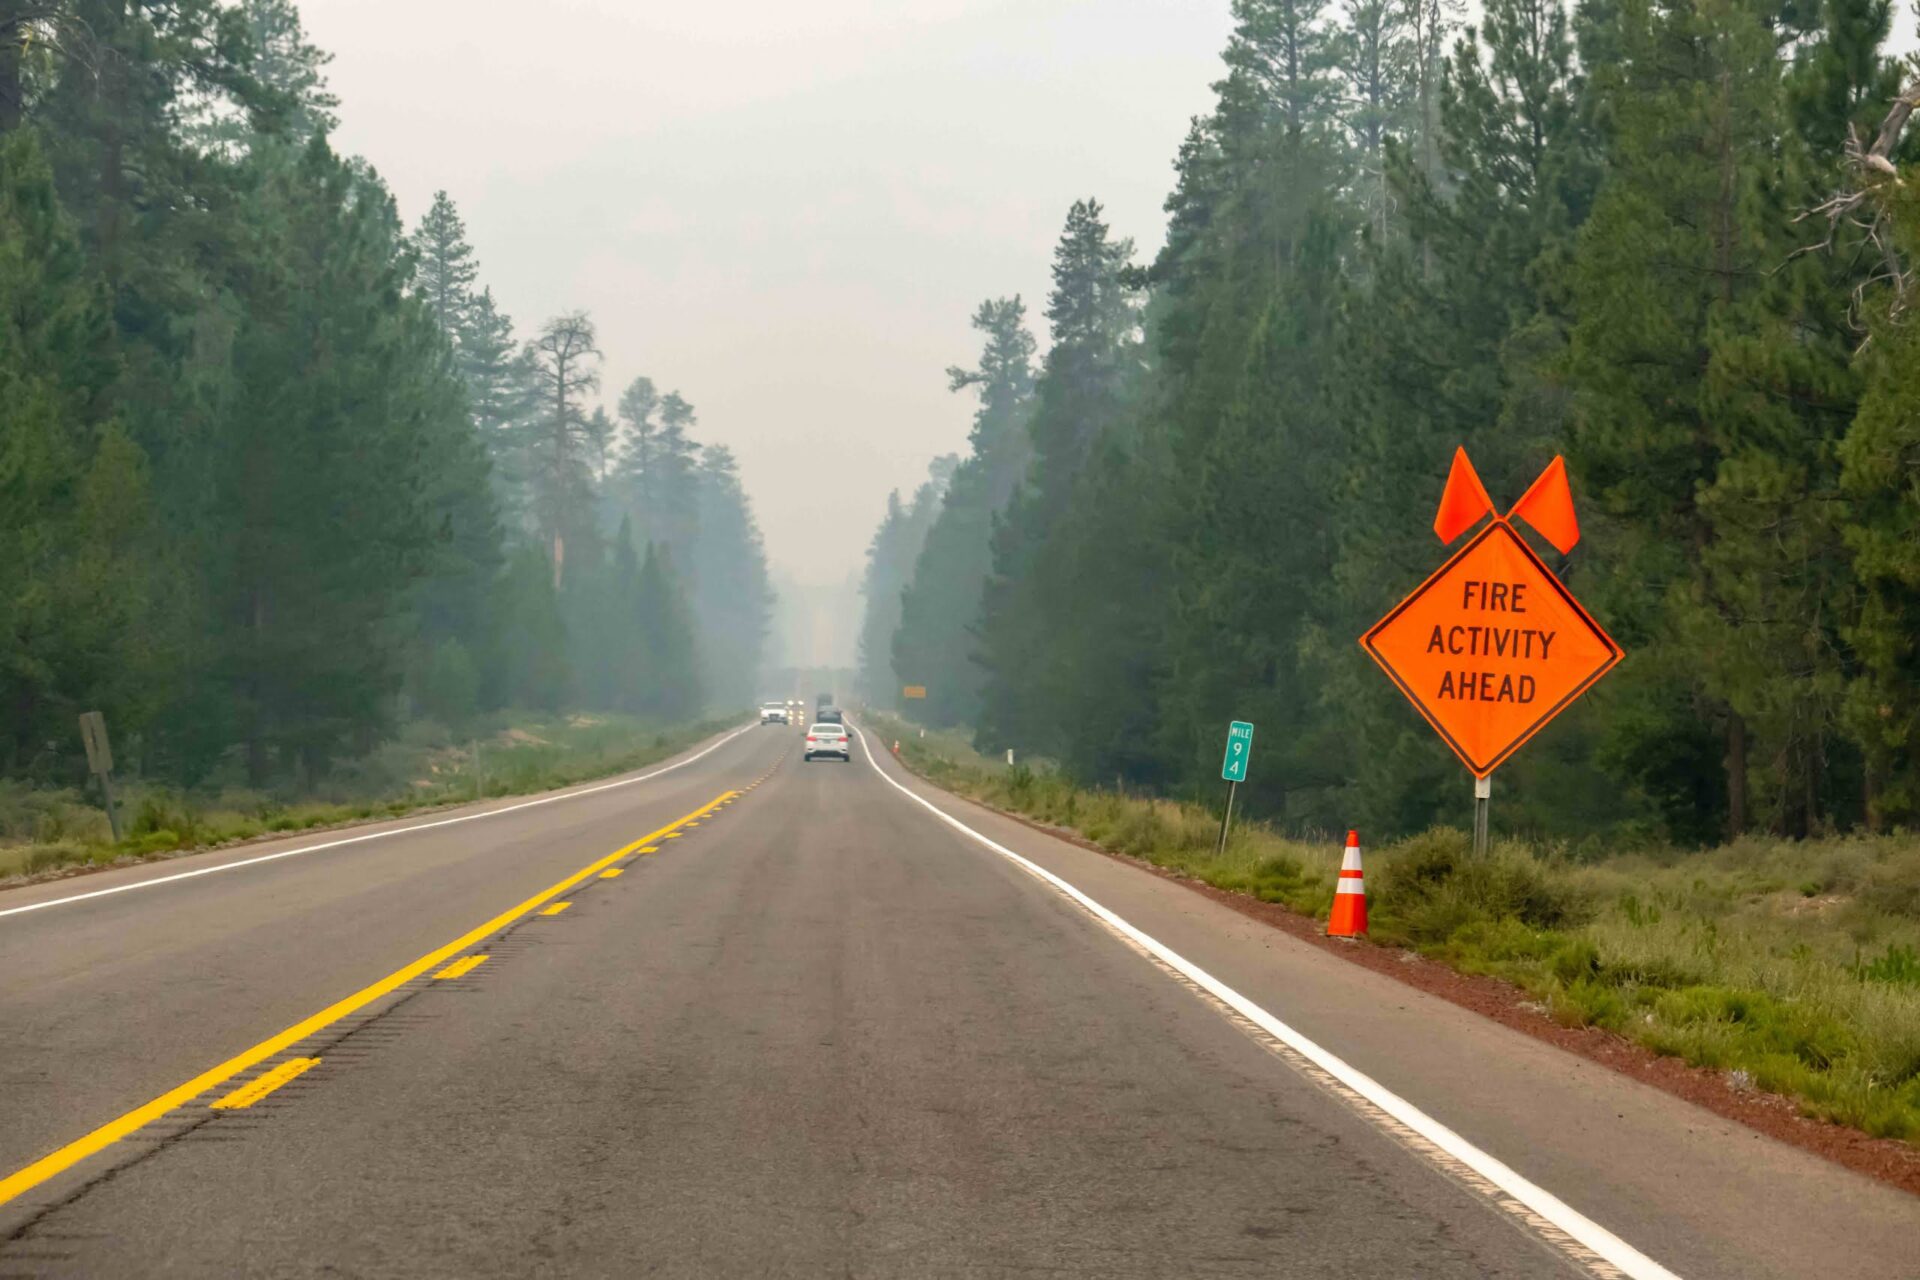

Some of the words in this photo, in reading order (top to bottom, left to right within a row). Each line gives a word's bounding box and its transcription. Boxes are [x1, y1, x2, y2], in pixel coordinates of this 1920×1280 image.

[1463, 581, 1527, 613] FIRE
[1427, 624, 1556, 660] ACTIVITY
[1437, 671, 1536, 704] AHEAD
[1231, 727, 1251, 739] MILE
